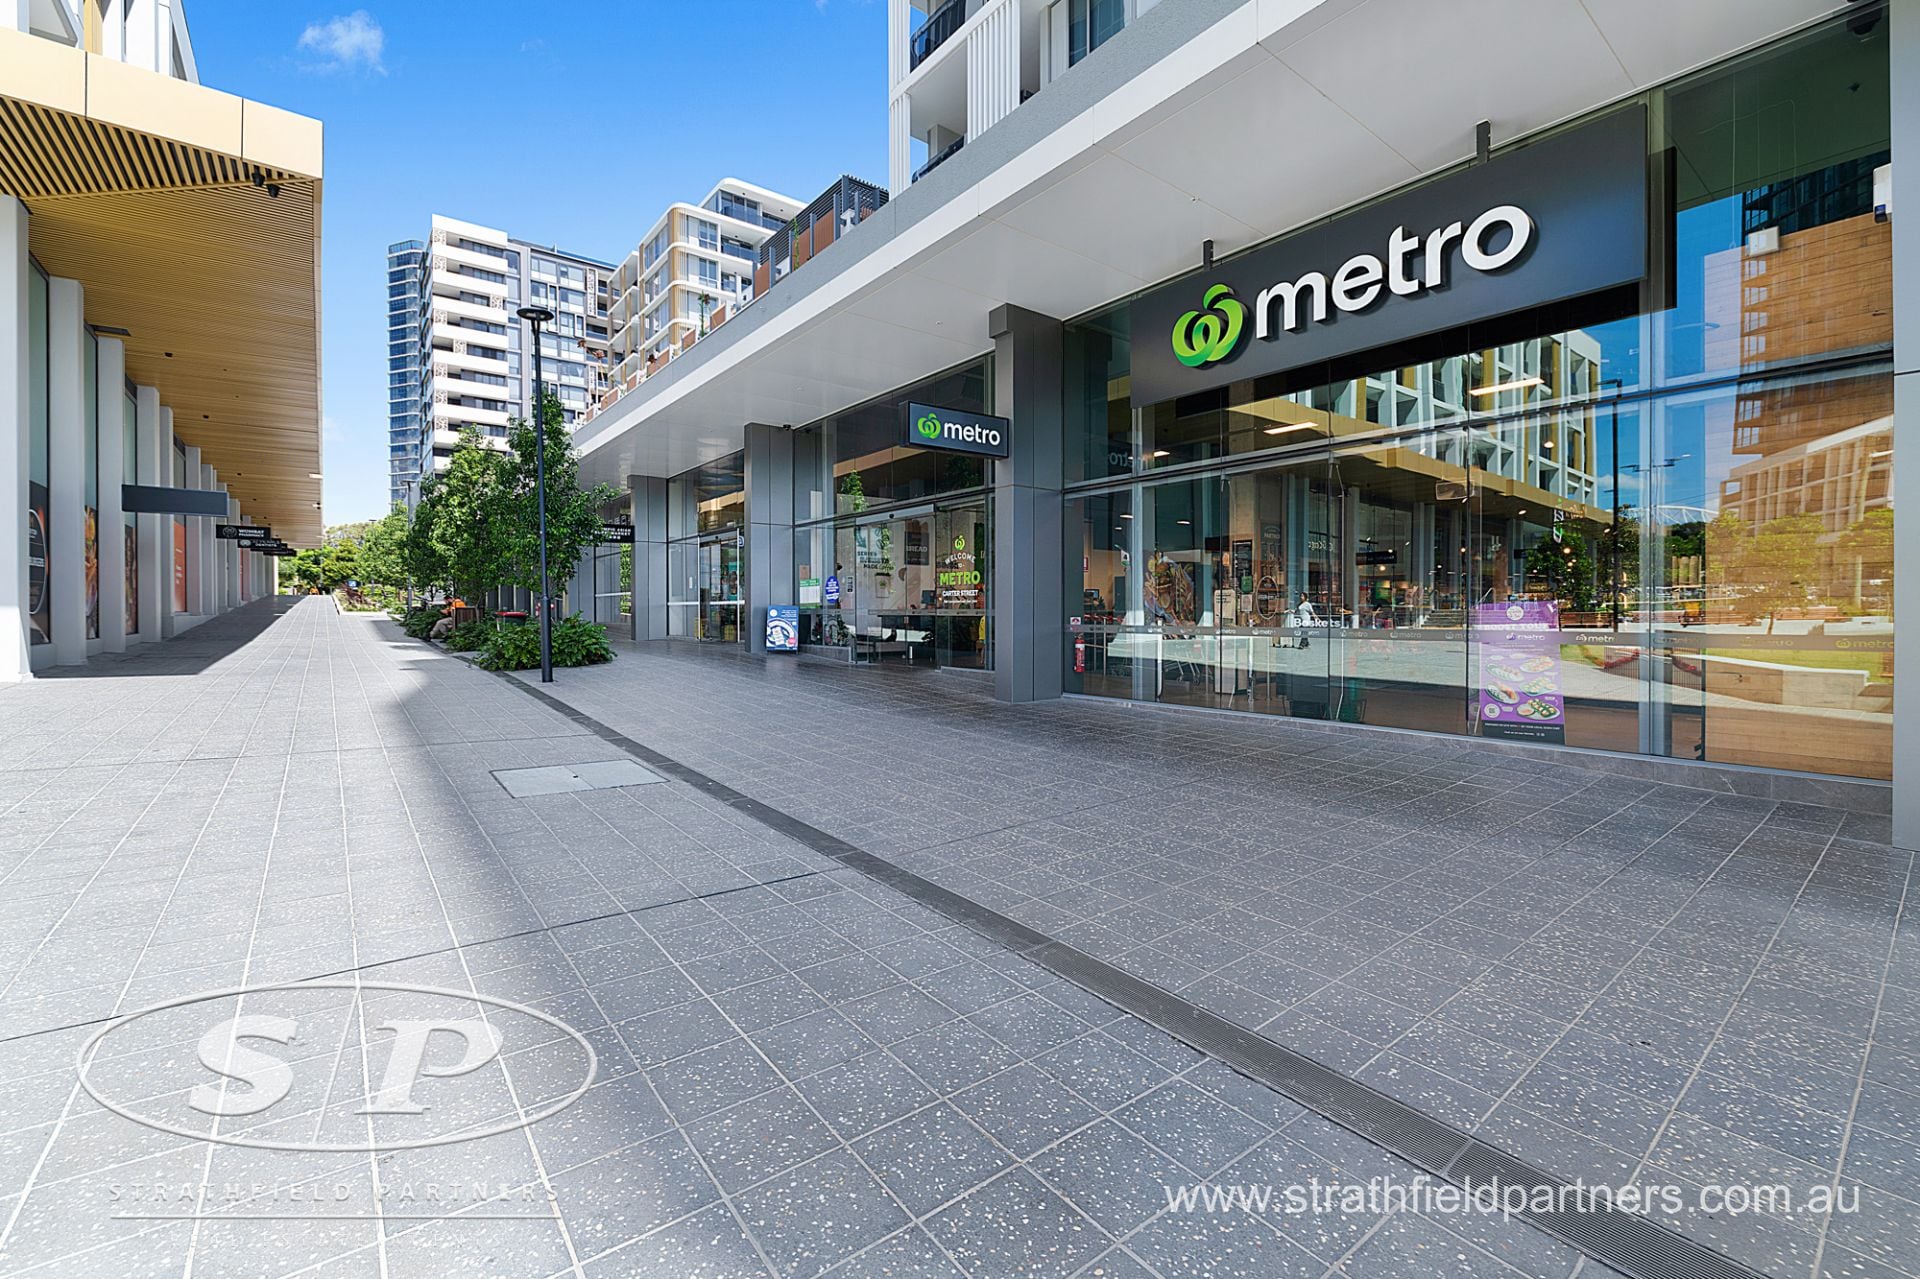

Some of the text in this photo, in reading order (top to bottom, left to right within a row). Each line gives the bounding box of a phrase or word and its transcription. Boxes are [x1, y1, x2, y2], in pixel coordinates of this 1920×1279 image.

[1256, 205, 1532, 339] metro
[943, 422, 1001, 446] metro
[944, 552, 976, 565] WELCOME
[940, 571, 981, 586] METRO
[1293, 618, 1341, 628] Baskets
